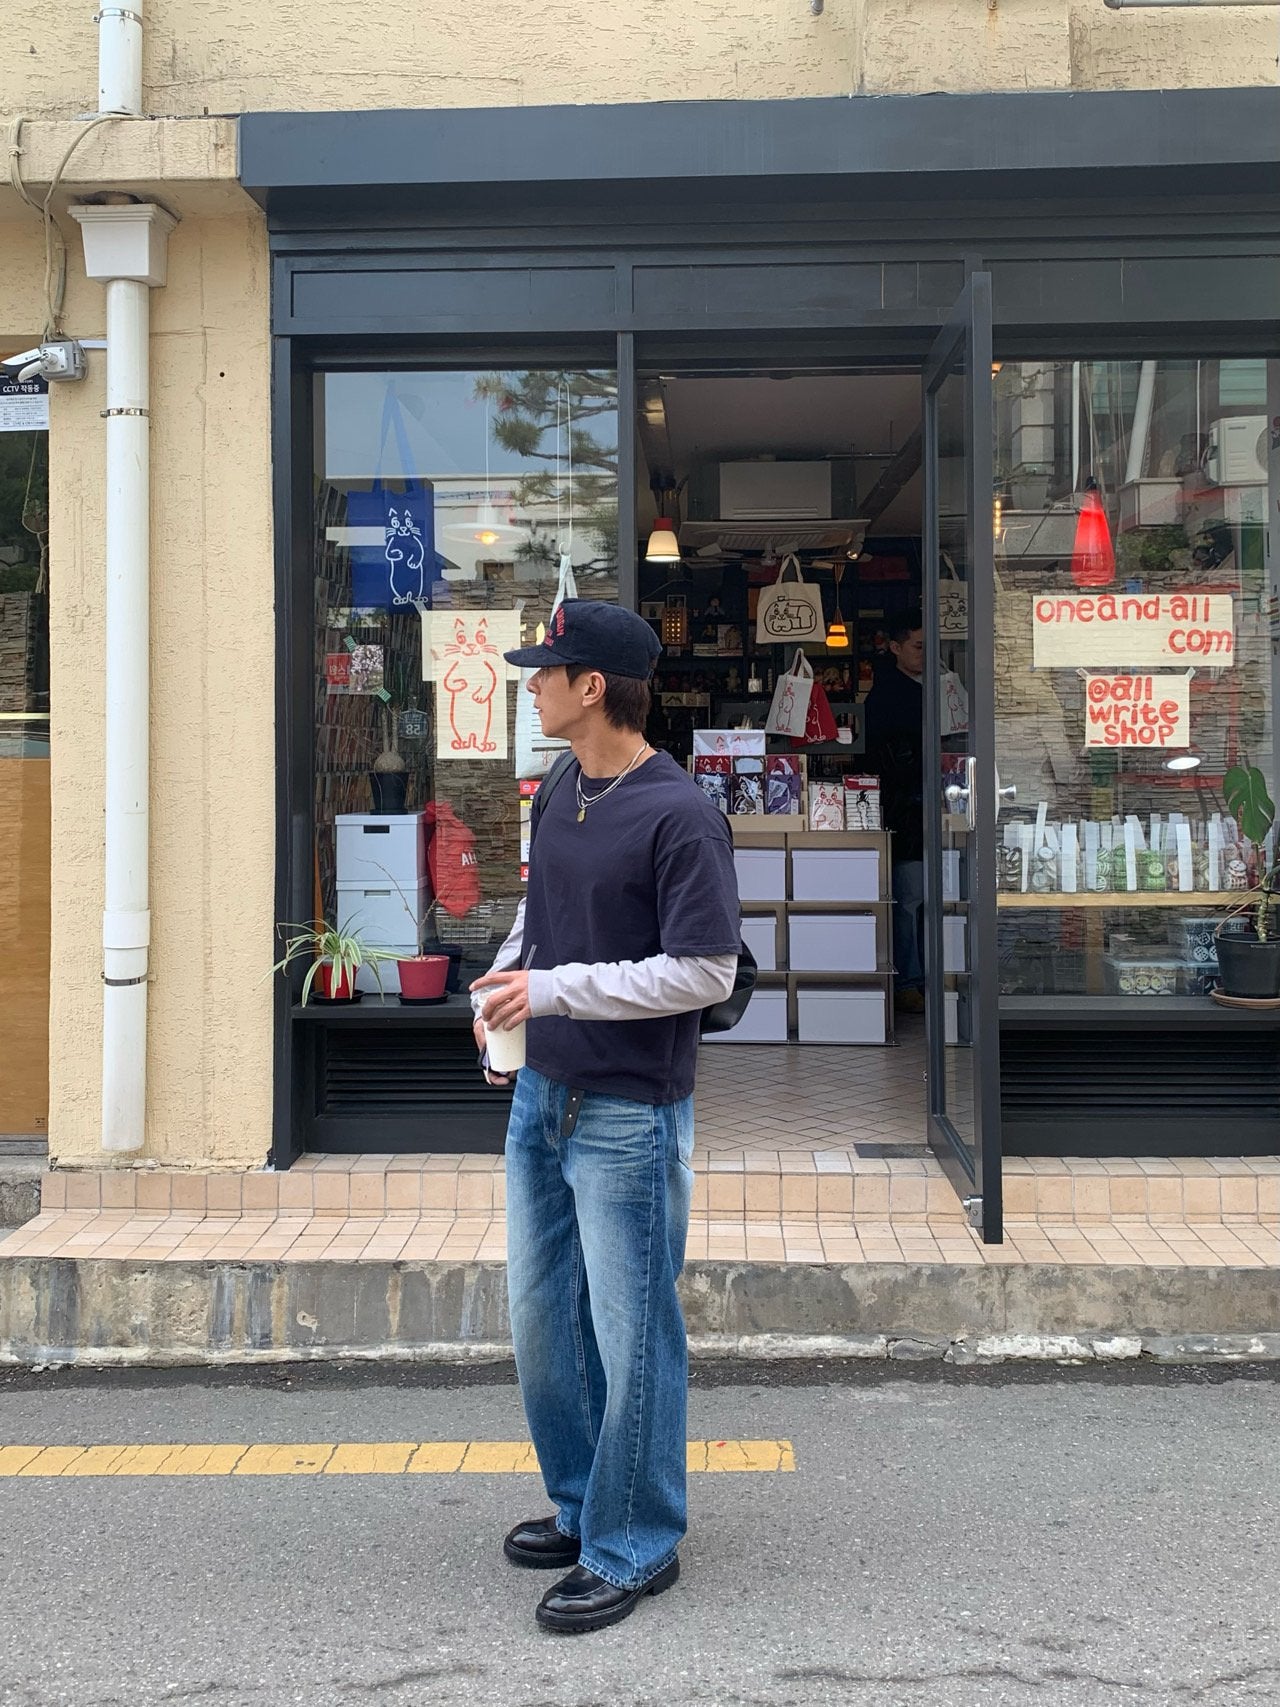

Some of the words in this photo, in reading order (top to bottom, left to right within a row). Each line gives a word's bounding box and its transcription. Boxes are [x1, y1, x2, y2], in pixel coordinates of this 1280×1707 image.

[2, 385, 20, 393] CCTV
[20, 384, 40, 393] 작동중
[1035, 594, 1210, 623] oneand-all
[1162, 627, 1233, 656] .com
[1087, 675, 1153, 703] @all
[1088, 700, 1180, 726] write
